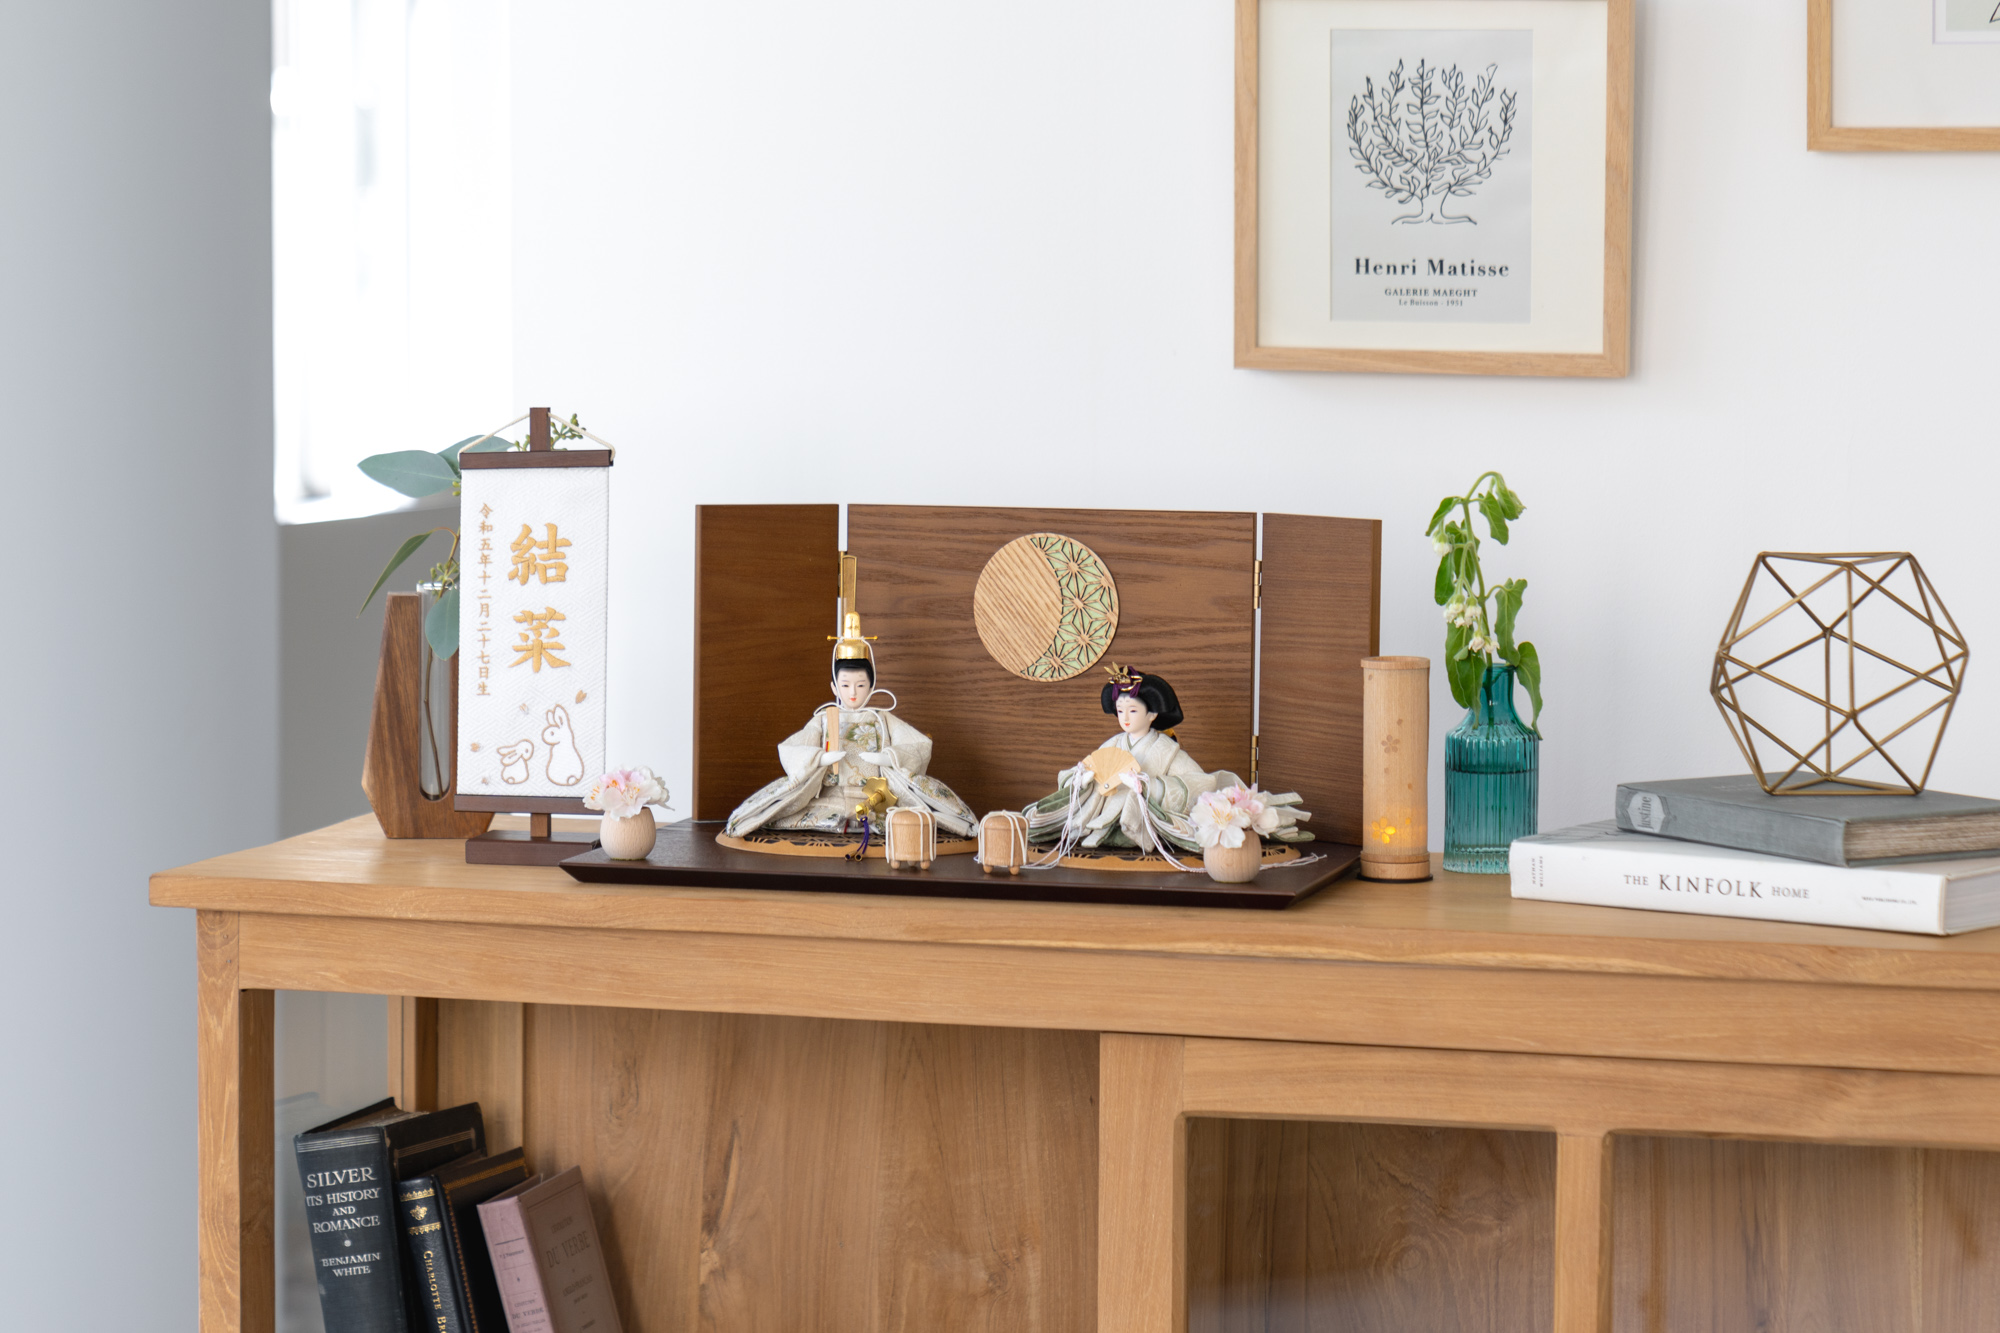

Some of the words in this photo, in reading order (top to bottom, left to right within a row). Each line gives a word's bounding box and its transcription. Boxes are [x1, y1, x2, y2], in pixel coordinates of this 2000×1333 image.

[1354, 256, 1417, 276] Henri
[1427, 257, 1510, 277] Matisse
[1384, 288, 1430, 297] GALERIE
[1432, 288, 1478, 298] MAEGHT
[1446, 299, 1464, 307] 1951
[476, 502, 494, 697] 令和五年十二月二十七日生
[508, 522, 573, 674] 結菜
[1623, 874, 1649, 886] THE
[1658, 873, 1763, 899] KINFOLK
[1771, 886, 1810, 899] HOME
[307, 1166, 378, 1189] SILVER
[305, 1195, 323, 1207] ITS
[326, 1187, 381, 1205] HISTORY
[332, 1205, 356, 1217] AND
[312, 1215, 381, 1234] ROMANCE
[321, 1252, 381, 1267] BENJAMIN
[332, 1265, 372, 1278] WHITE
[423, 1250, 442, 1311] CHARLOTTE
